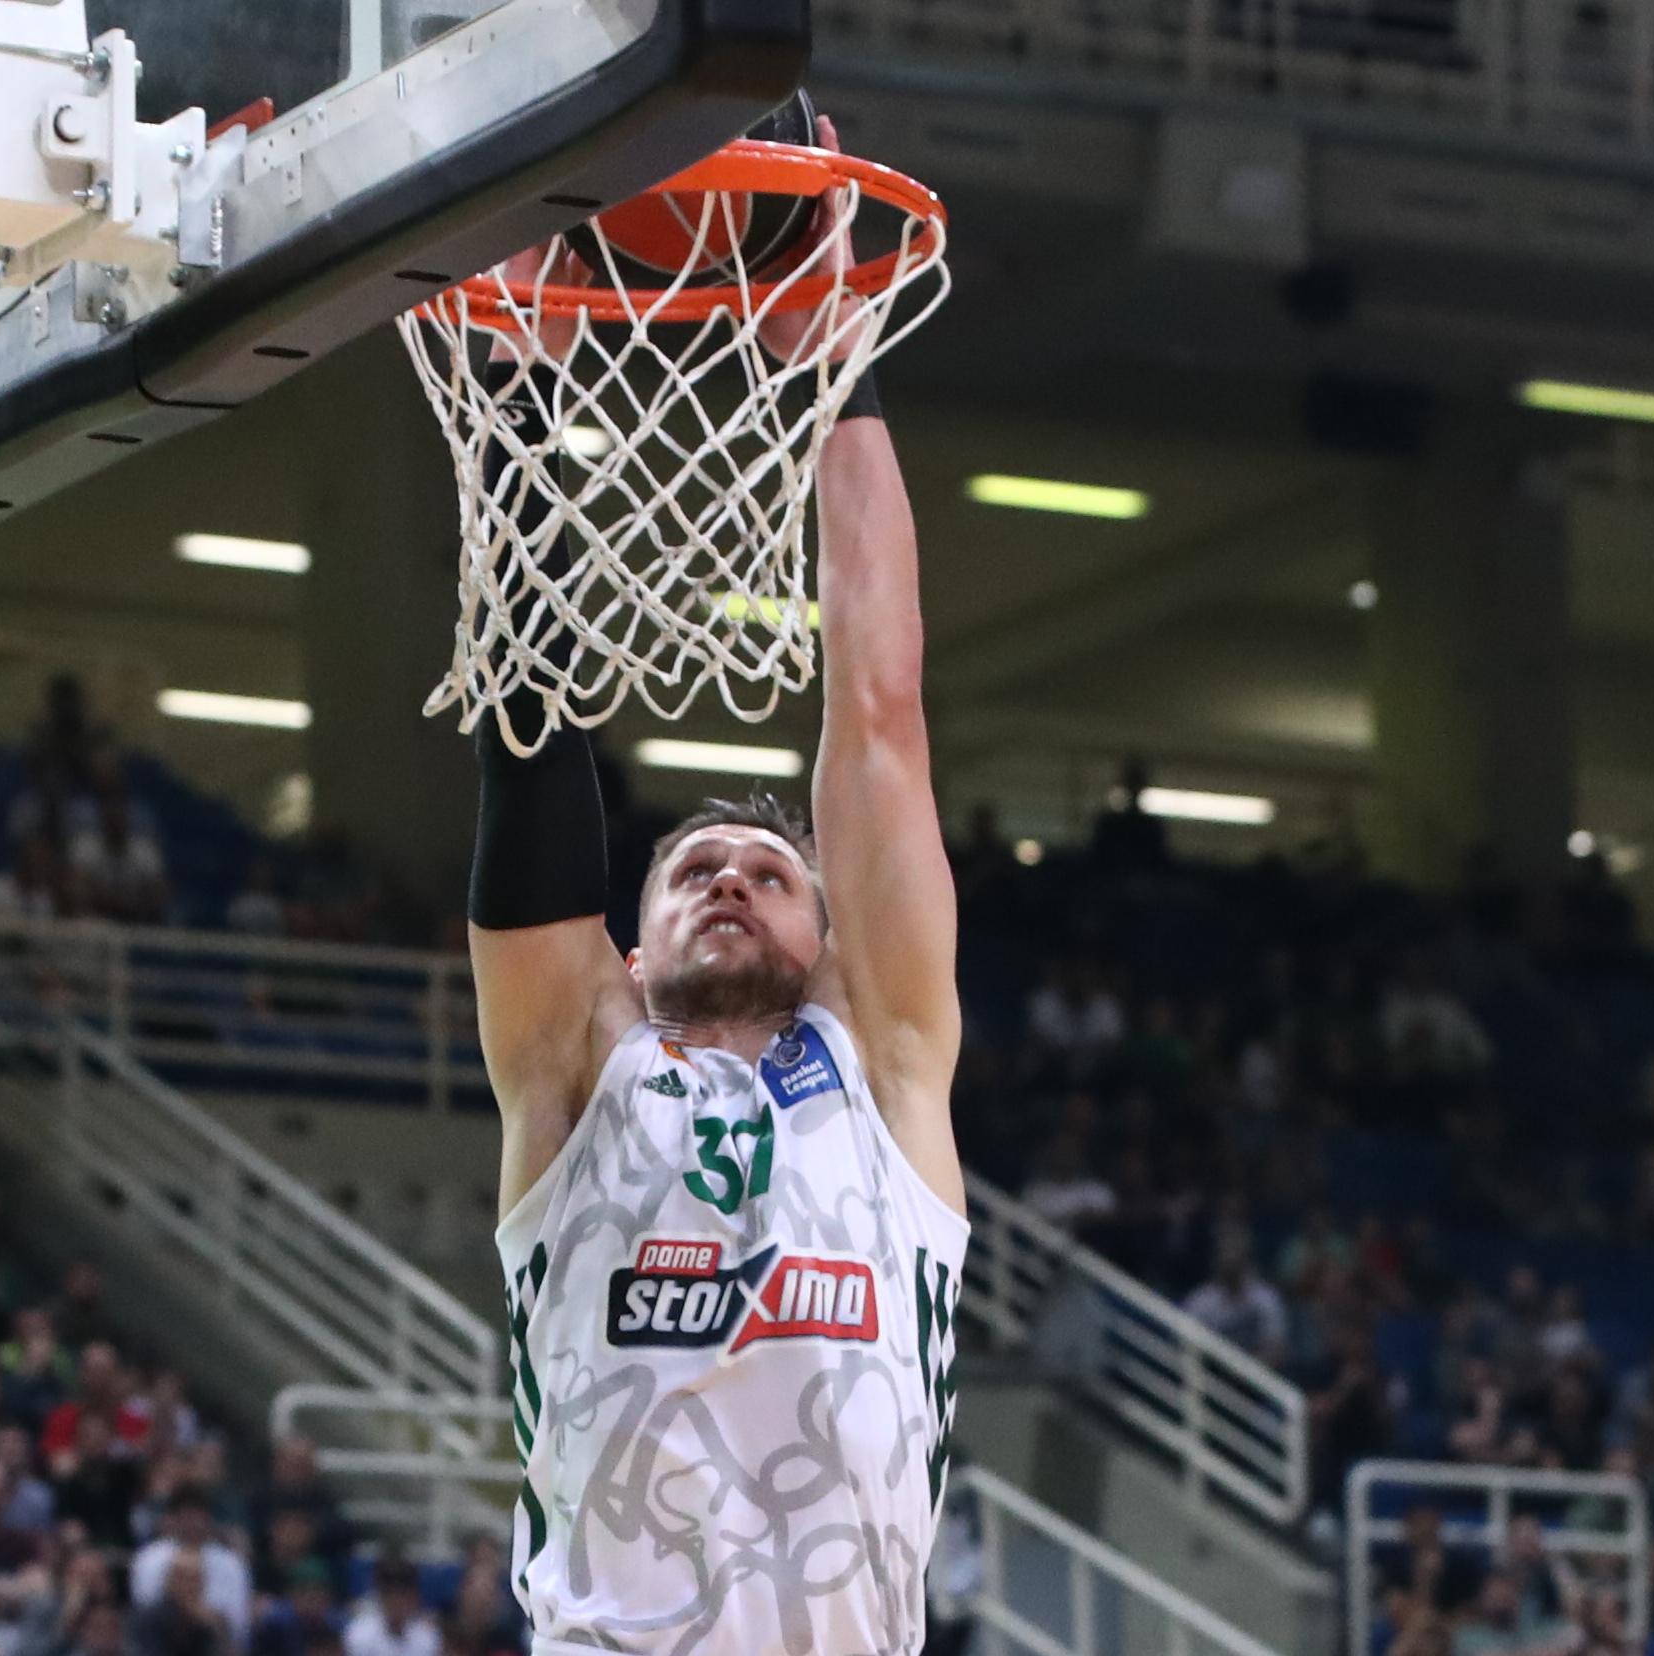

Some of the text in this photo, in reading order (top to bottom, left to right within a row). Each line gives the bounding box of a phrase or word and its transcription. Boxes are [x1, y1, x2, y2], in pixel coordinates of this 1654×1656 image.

[780, 1059, 824, 1087] Basket
[784, 1070, 829, 1096] League
[682, 1101, 774, 1215] 37
[641, 1244, 713, 1270] pame
